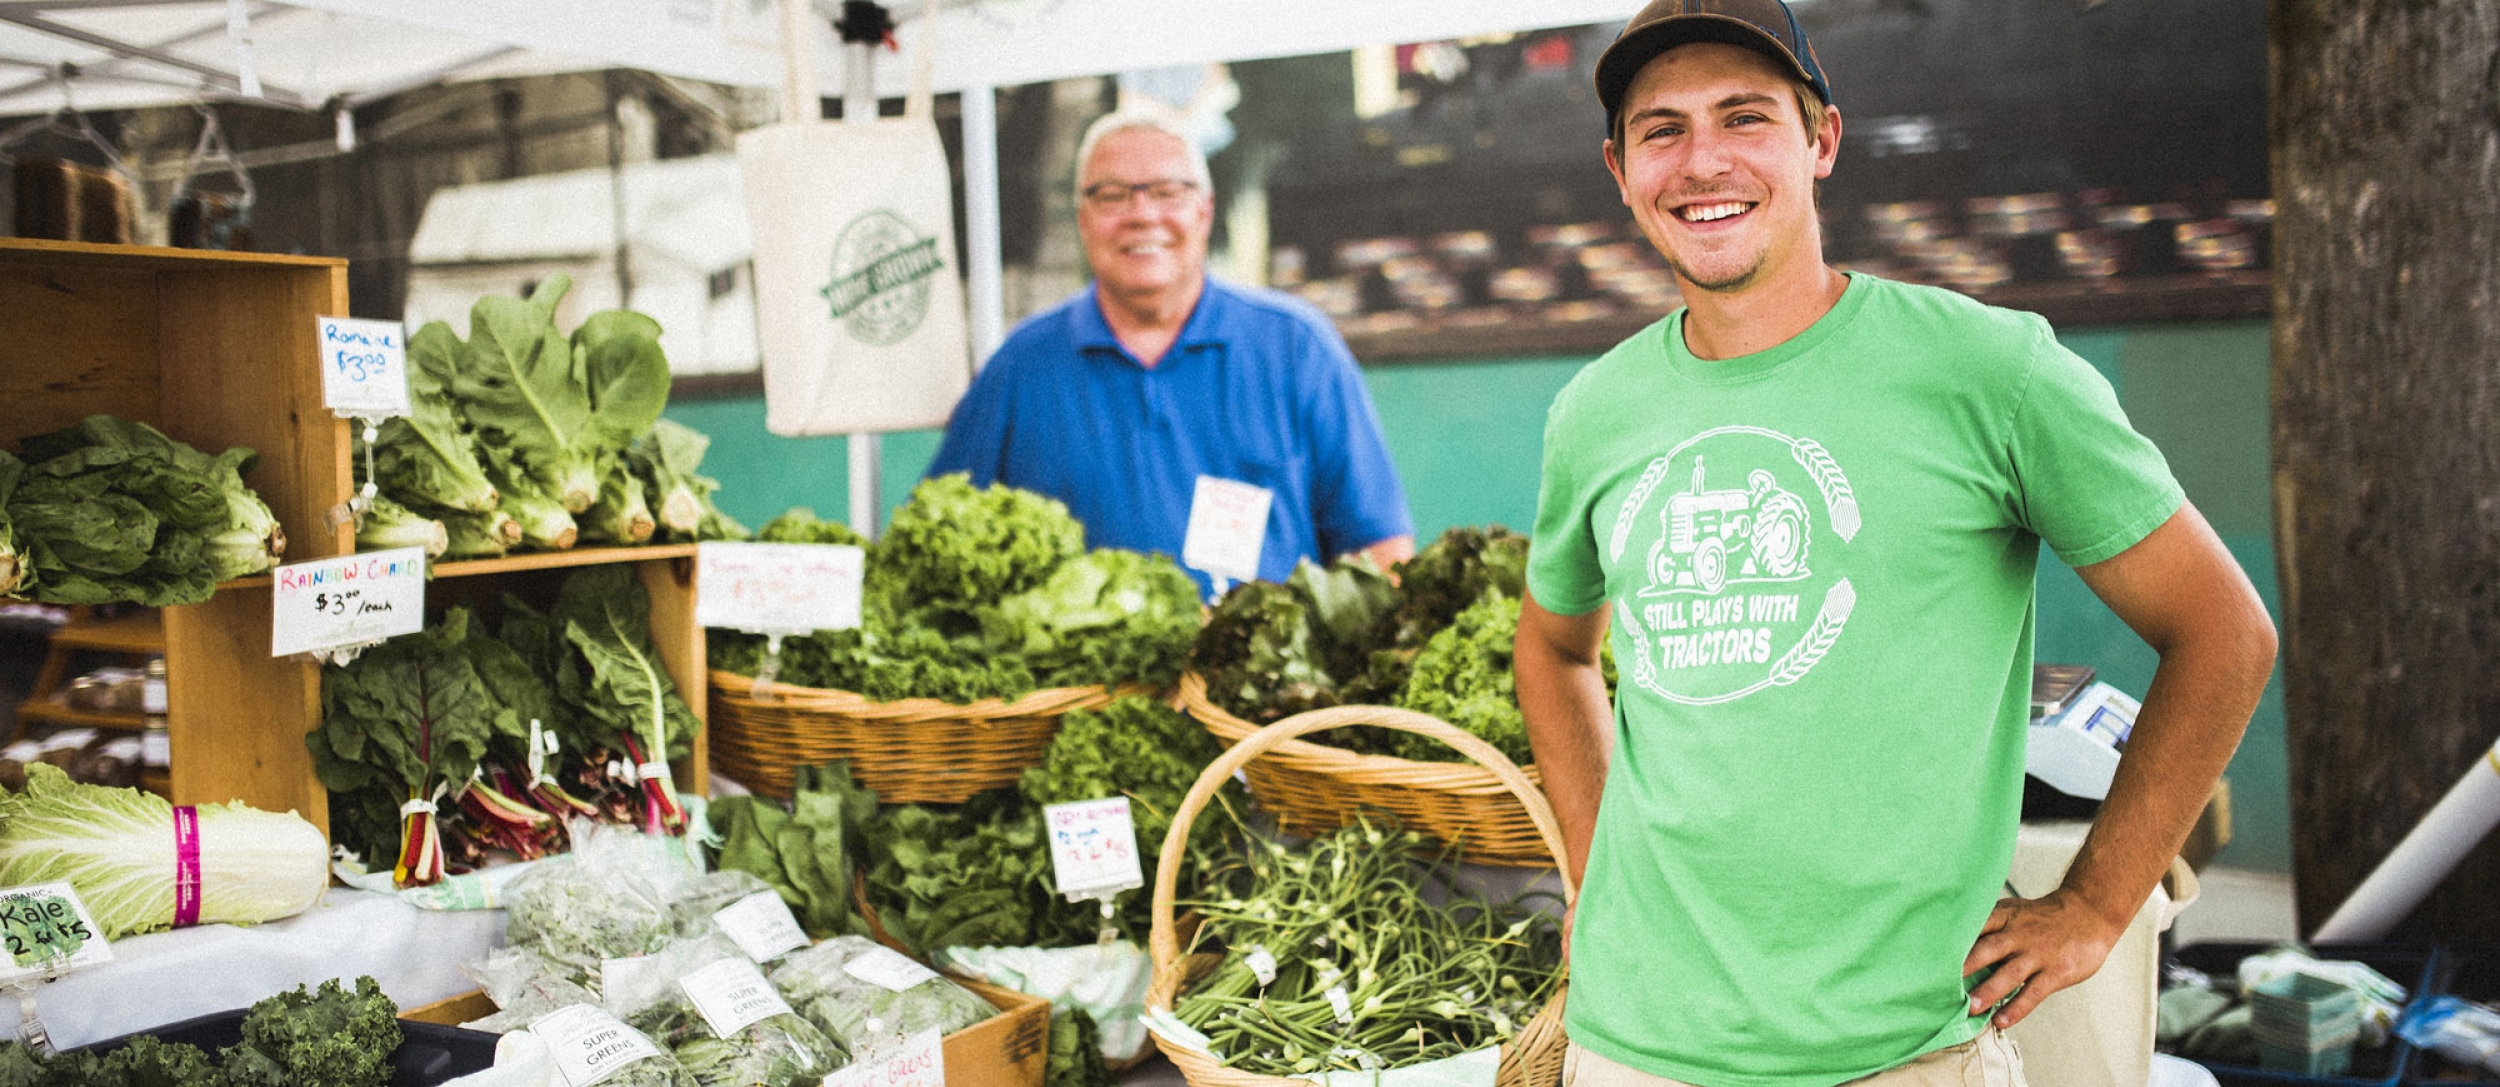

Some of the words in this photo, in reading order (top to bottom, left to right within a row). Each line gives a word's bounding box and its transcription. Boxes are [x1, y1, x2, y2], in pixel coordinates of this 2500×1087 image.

[280, 562, 358, 592] RAINBOW
[1644, 601, 1688, 631] STILL
[1691, 594, 1744, 628] PLAYS
[1748, 593, 1799, 623] WITH
[1659, 627, 1772, 670] TRACTORS
[0, 902, 64, 930] Kale
[6, 936, 31, 955] 2
[583, 1028, 620, 1050] SUPER
[586, 1039, 636, 1065] GREENS
